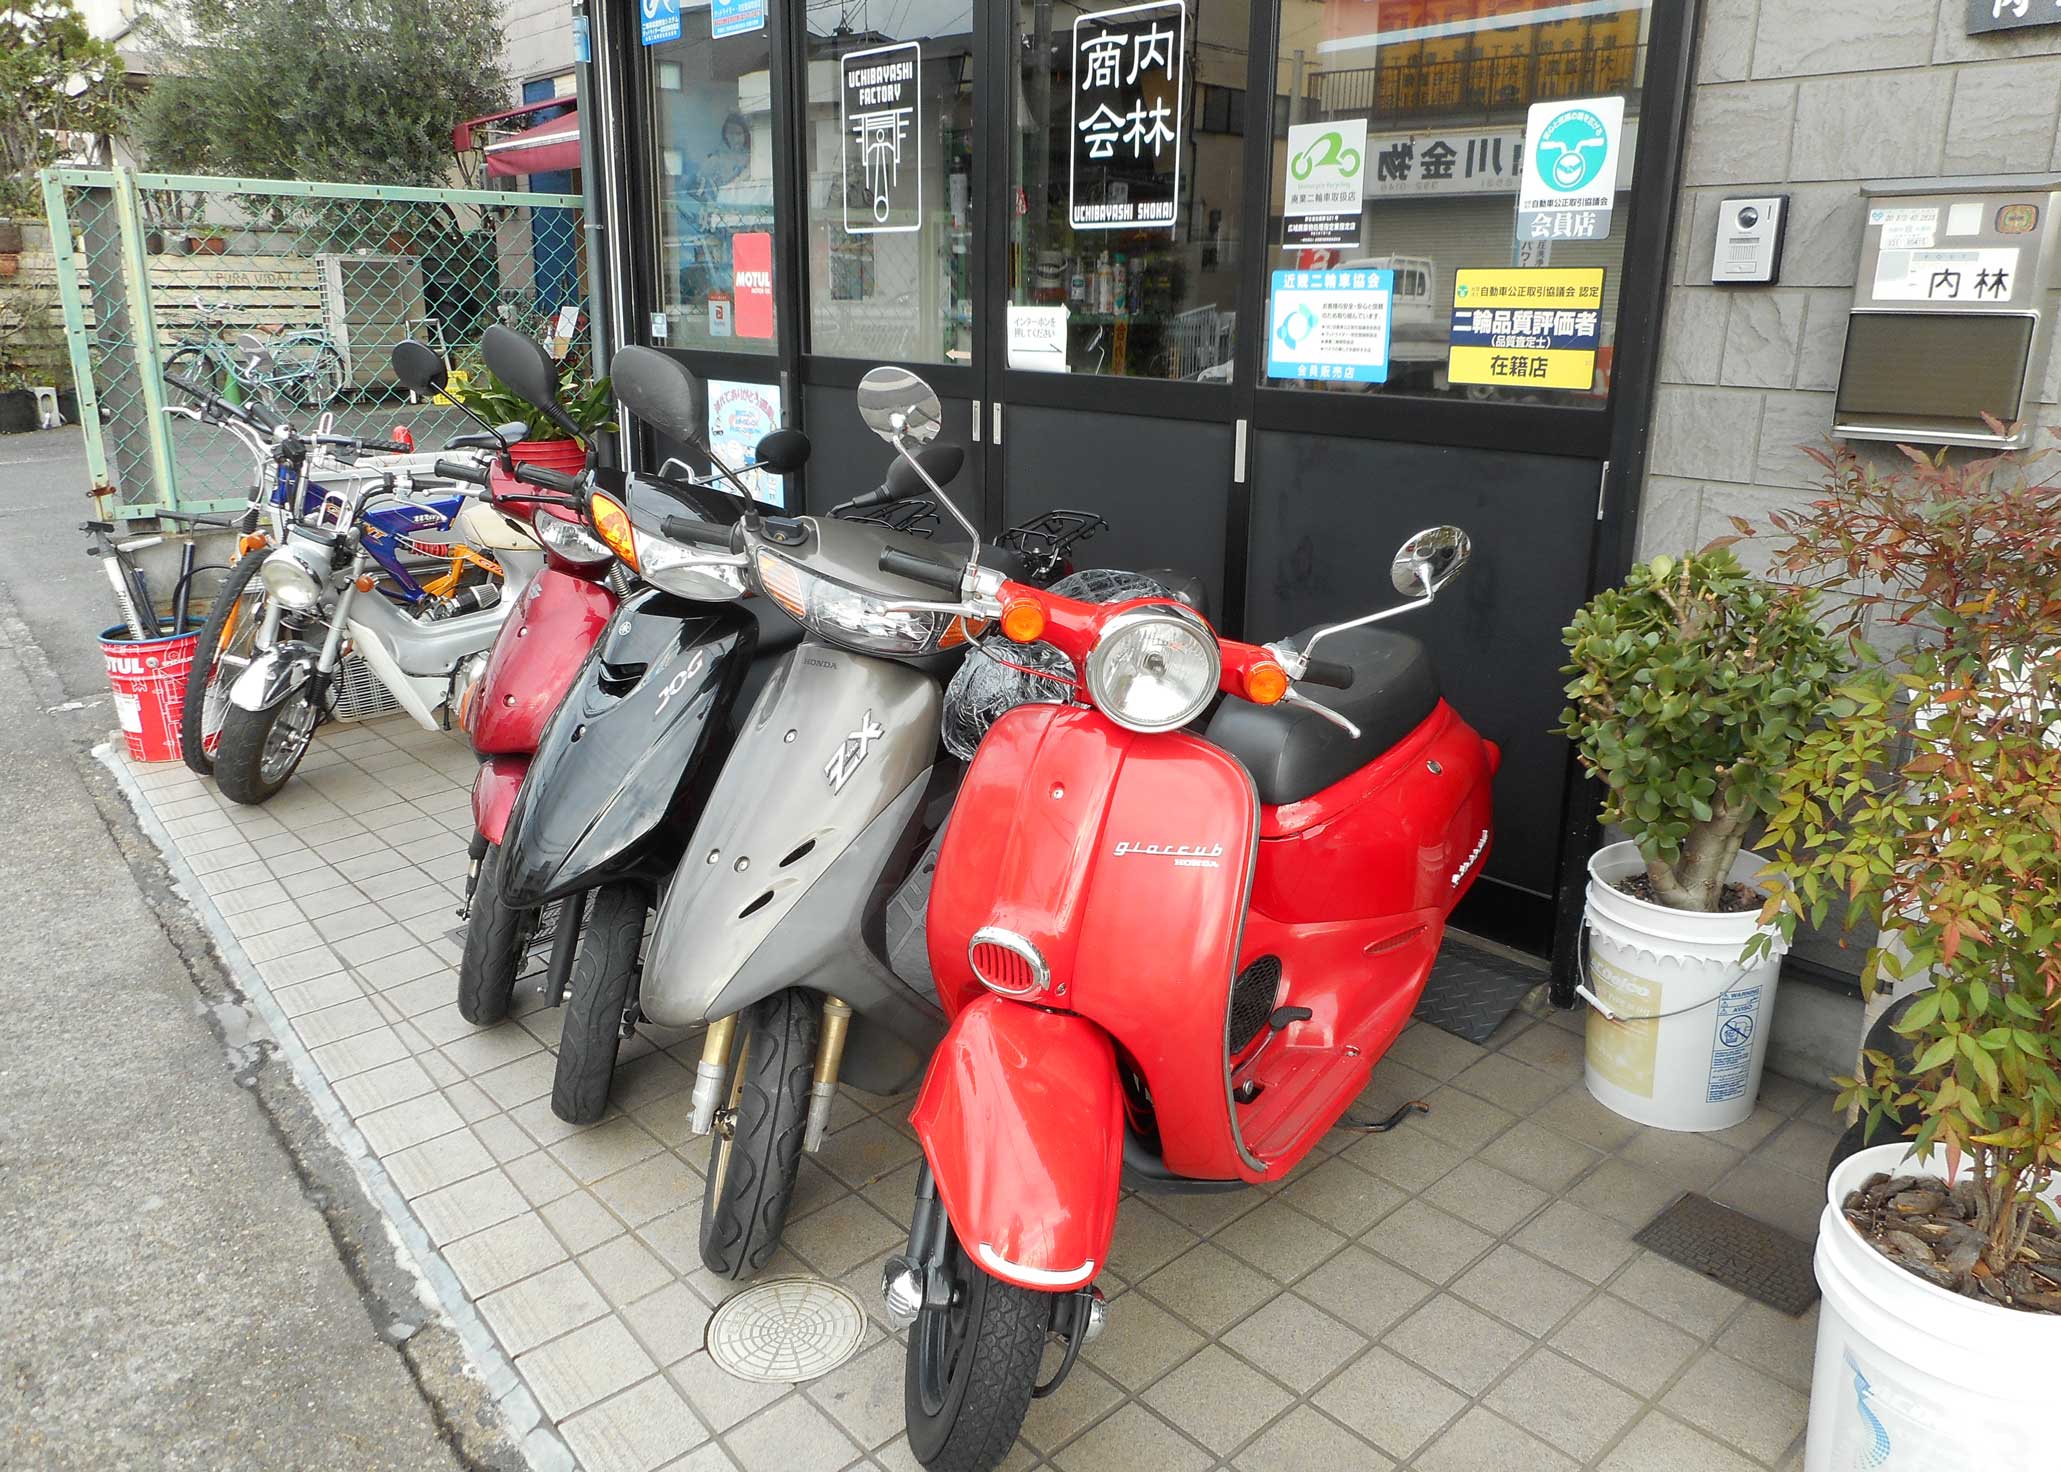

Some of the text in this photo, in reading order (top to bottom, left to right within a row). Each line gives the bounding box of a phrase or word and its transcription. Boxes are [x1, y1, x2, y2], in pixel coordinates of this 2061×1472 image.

[848, 61, 913, 88] UCHIBAYASHI
[859, 83, 901, 106] FACTORY
[1078, 29, 1129, 159] 商会
[1123, 22, 1175, 158] 内林
[1074, 202, 1173, 222] UCHIBAYASHI SHOKAI
[1531, 211, 1596, 238] 会員店
[735, 271, 771, 288] MOTUL
[1480, 286, 1576, 298] 自動車公正取引協議会
[1578, 286, 1599, 298] 認定
[1013, 317, 1056, 328] インターホンを
[1452, 309, 1598, 337] 二輪品質評価者
[1297, 364, 1355, 379] 会員販売店
[1490, 354, 1549, 378] 在籍店
[804, 658, 838, 669] HONDA
[654, 649, 704, 716] JOG
[823, 708, 885, 796] ZX
[1730, 987, 1760, 999] WARNING
